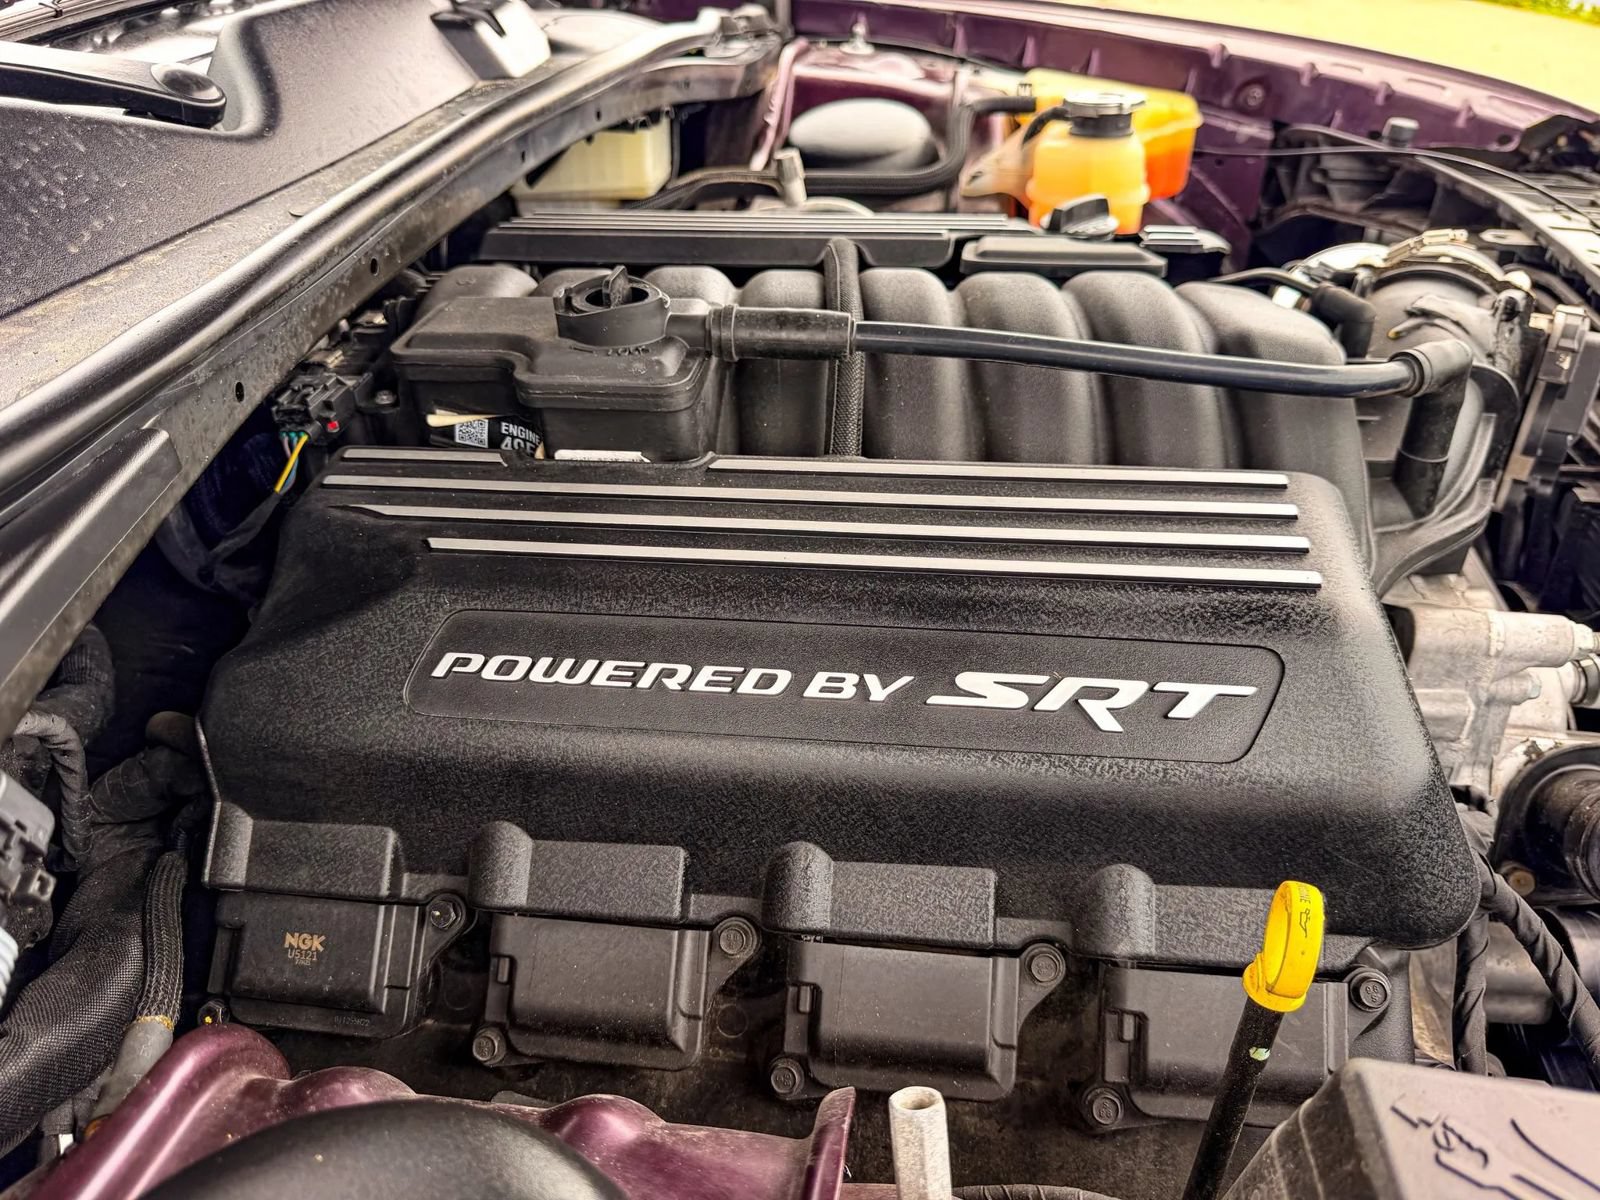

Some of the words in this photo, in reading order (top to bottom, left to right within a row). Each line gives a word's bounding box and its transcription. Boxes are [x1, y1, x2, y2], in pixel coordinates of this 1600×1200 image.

[501, 421, 541, 446] ENGINE
[431, 651, 792, 696] POWERED
[802, 671, 915, 702] BY
[925, 671, 1259, 733] SRT
[284, 931, 326, 952] NGK
[287, 947, 317, 961] U5121
